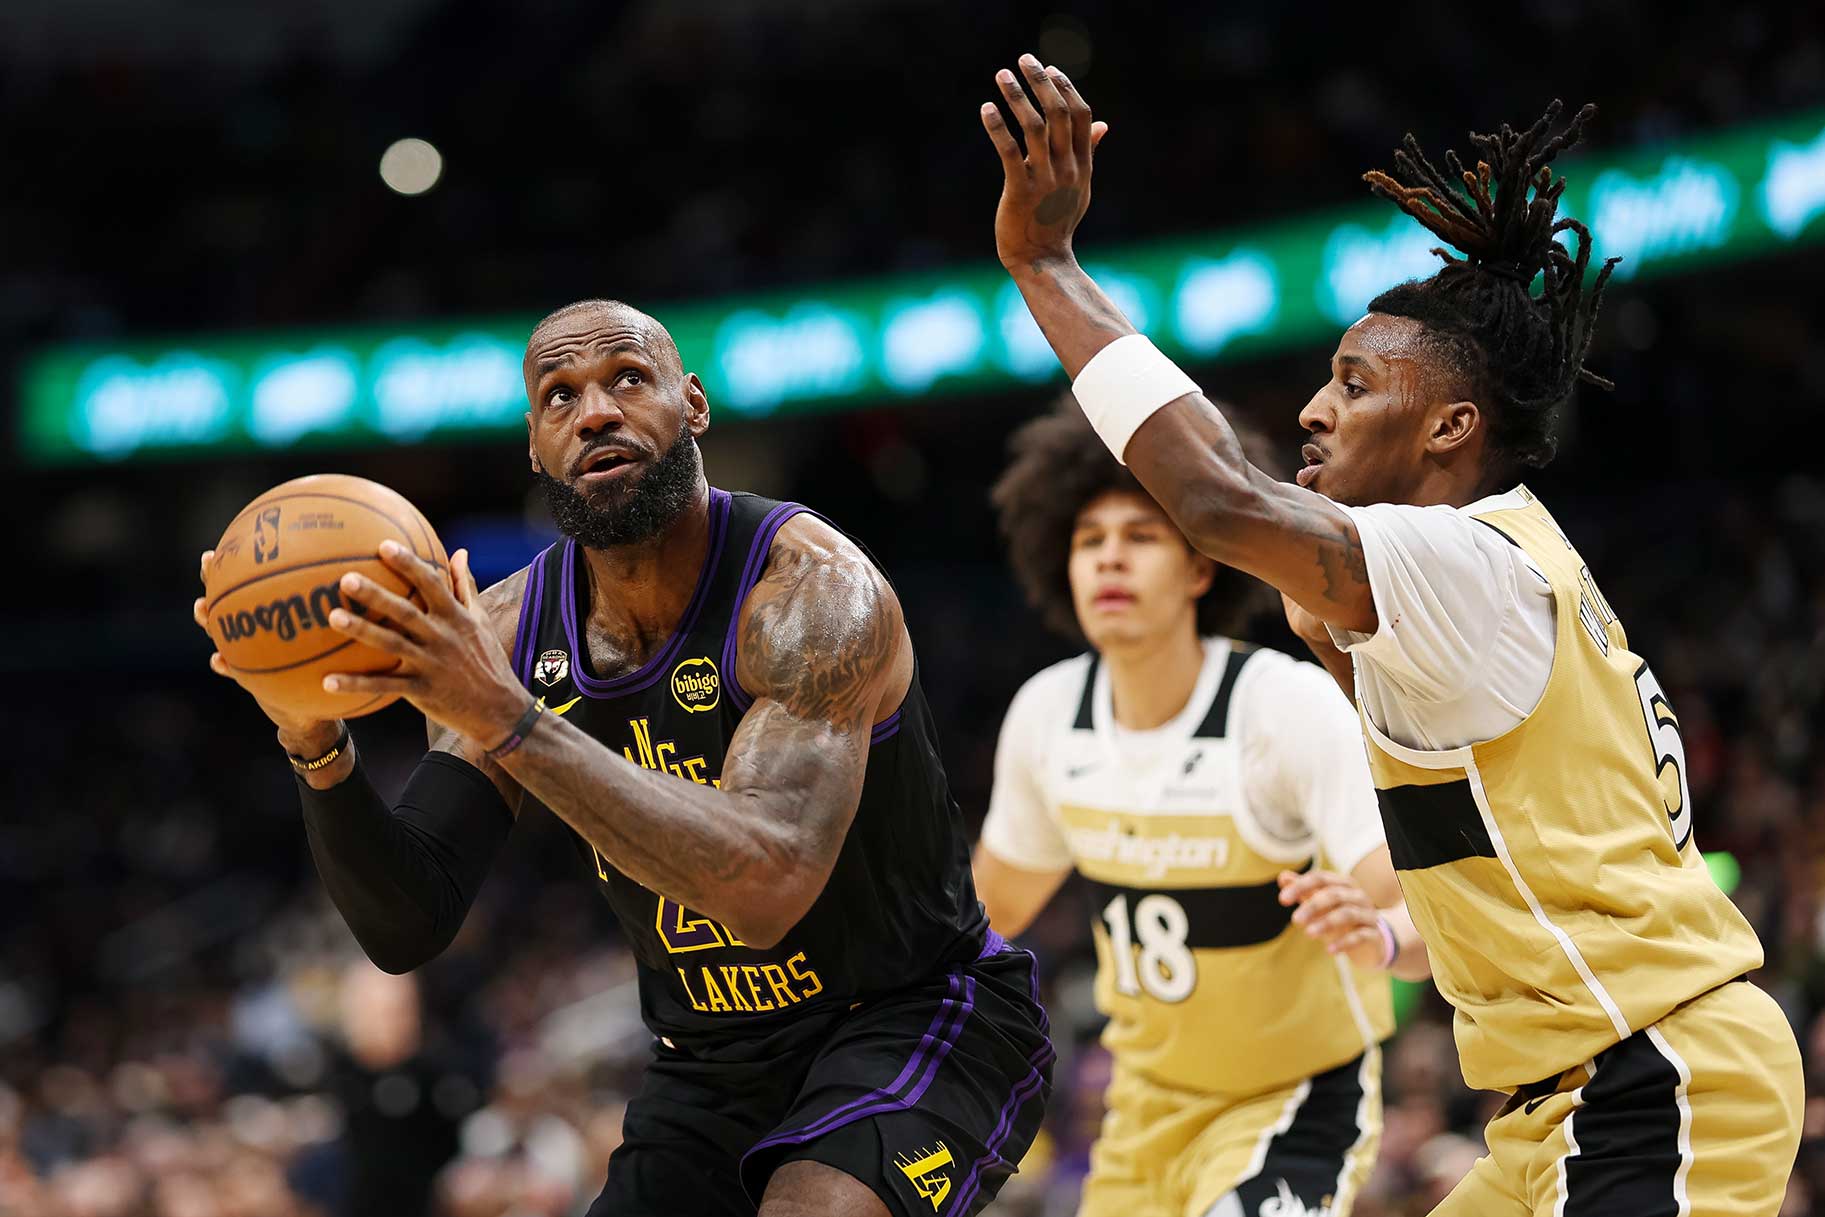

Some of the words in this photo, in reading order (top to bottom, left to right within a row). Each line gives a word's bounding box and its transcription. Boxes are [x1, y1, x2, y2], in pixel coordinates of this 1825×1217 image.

[674, 672, 718, 694] bibigo
[1634, 661, 1693, 852] 5
[677, 951, 823, 1012] LAKERS
[1103, 893, 1198, 1003] 18
